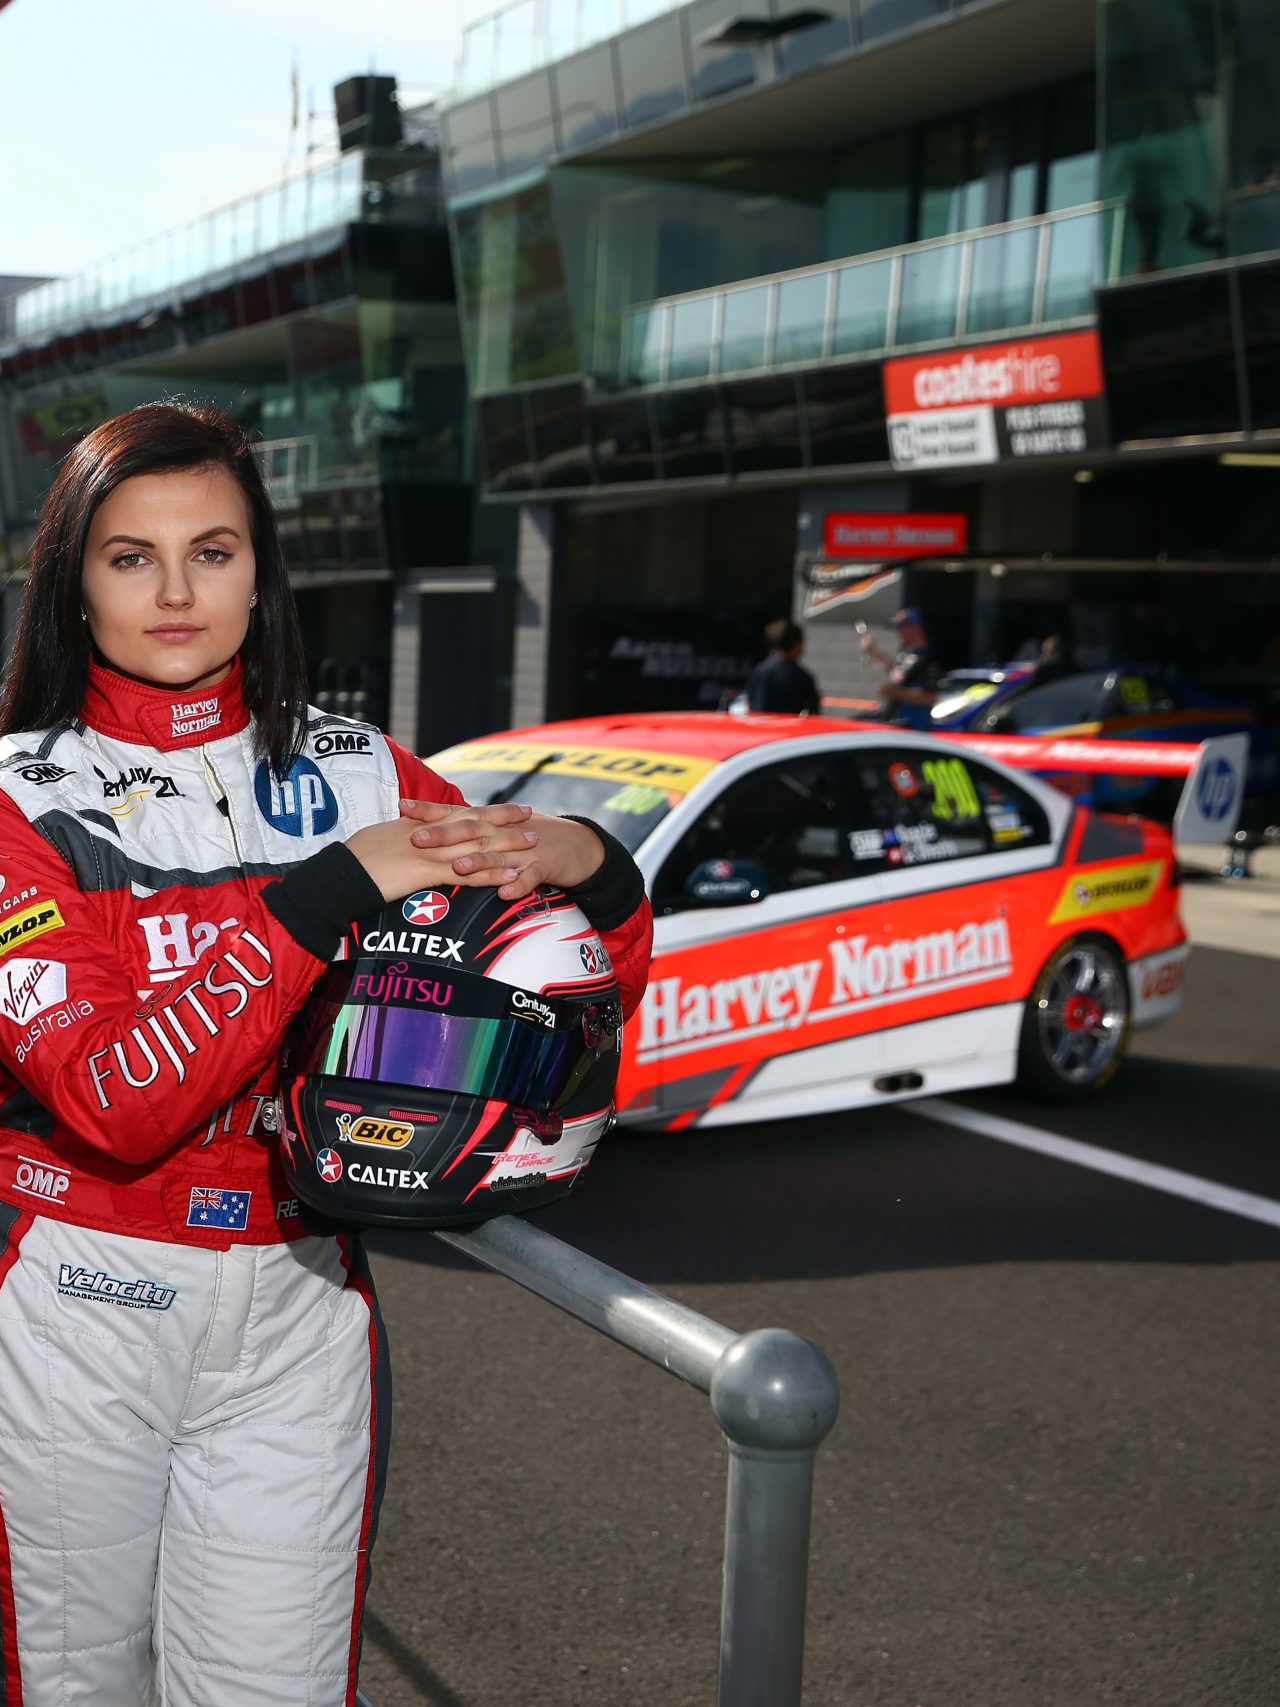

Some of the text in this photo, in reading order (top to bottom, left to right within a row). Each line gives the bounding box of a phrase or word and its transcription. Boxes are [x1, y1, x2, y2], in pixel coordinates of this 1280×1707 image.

[170, 697, 220, 719] Harvey
[170, 712, 221, 735] Norman
[314, 734, 370, 754] OMP
[475, 746, 687, 778] DUNLOP
[94, 765, 181, 798] entury 21
[362, 931, 465, 963] CALTEX
[4, 960, 49, 1018] Virgin
[353, 972, 454, 1006] FUJITSU
[637, 916, 1012, 1050] Harvey Norman
[86, 929, 273, 1111] FUJITSU
[512, 991, 556, 1028] Century 21
[15, 997, 94, 1062] australia
[16, 1163, 70, 1197] OMP
[347, 1163, 430, 1190] CALTEX
[58, 1288, 146, 1310] MANAGEMENT GROUP
[59, 1264, 176, 1310] Velocity
